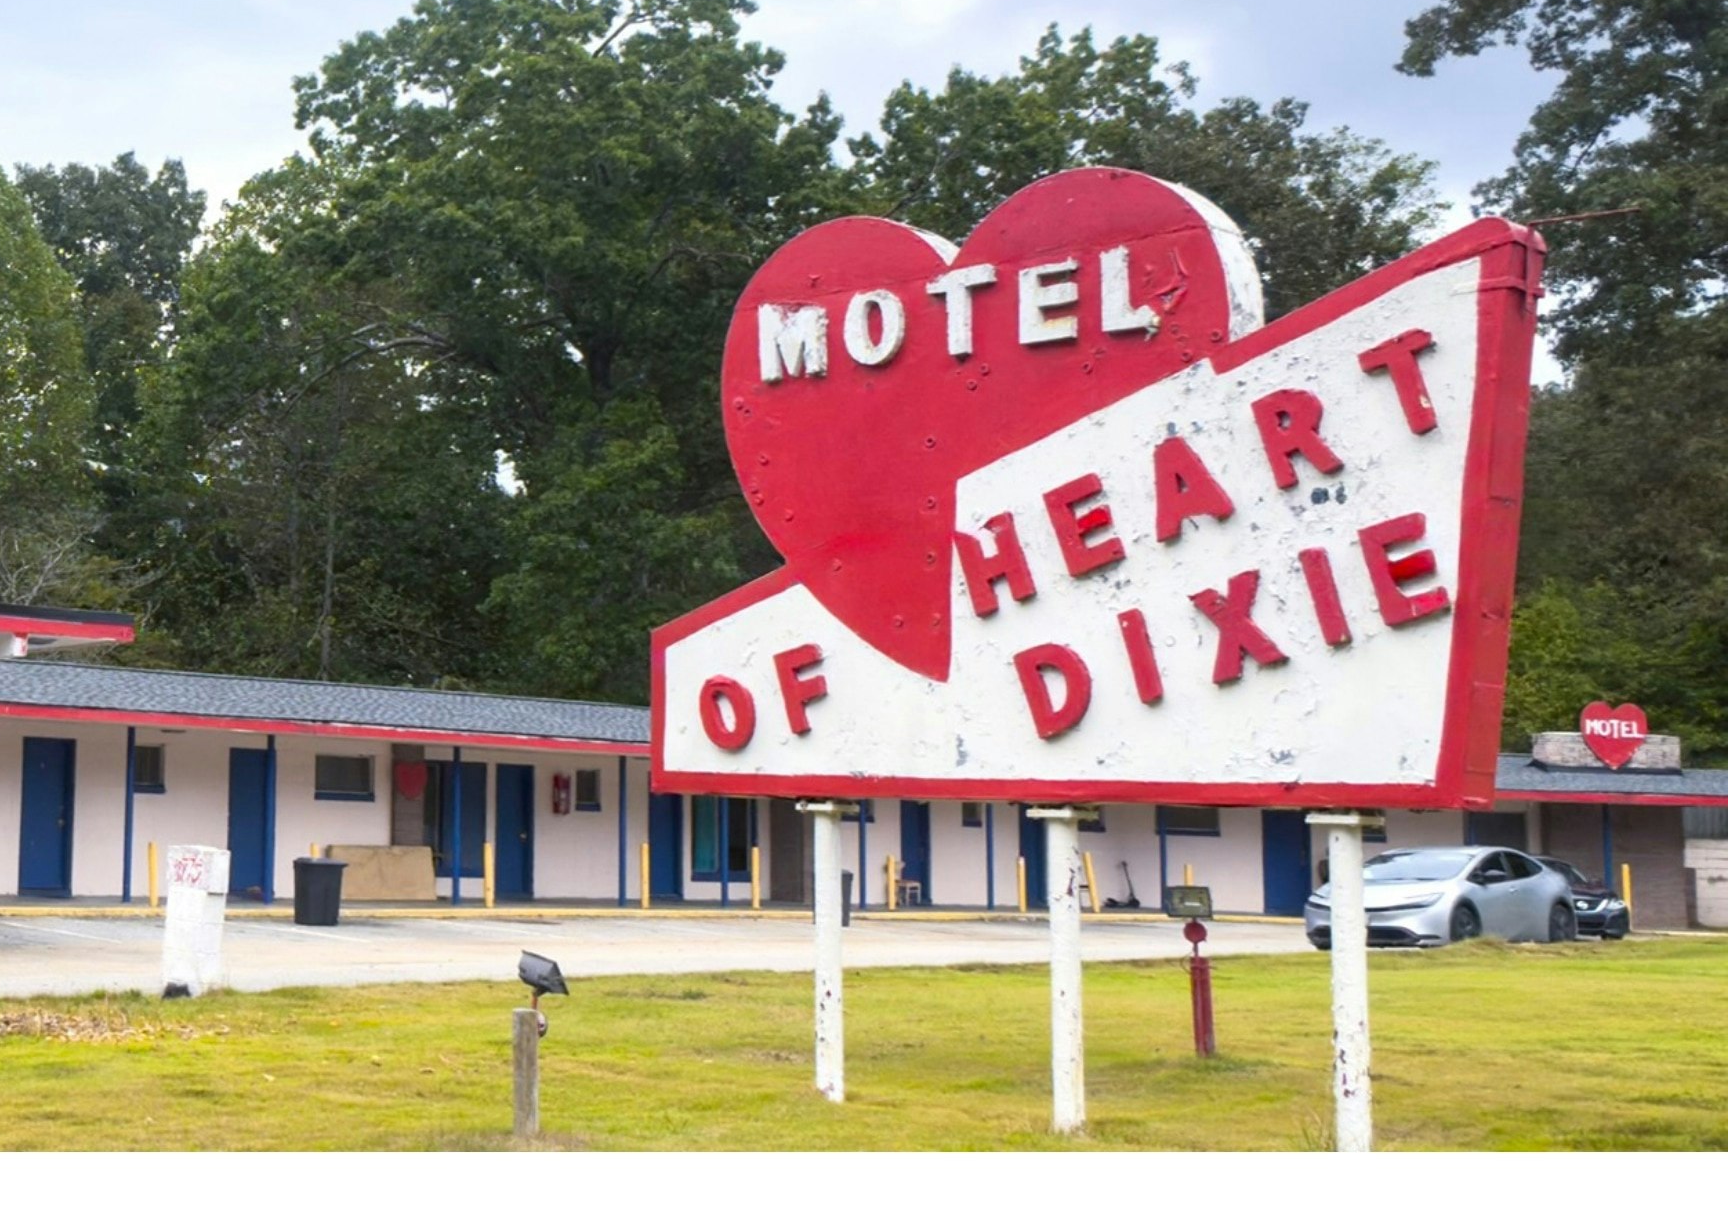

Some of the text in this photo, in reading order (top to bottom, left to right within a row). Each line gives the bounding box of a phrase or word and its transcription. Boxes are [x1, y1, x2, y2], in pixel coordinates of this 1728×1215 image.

[758, 245, 1161, 383] MOTEL
[953, 328, 1439, 619] HEART
[699, 512, 1450, 752] OF DIXIE
[1585, 719, 1646, 739] MOTEL
